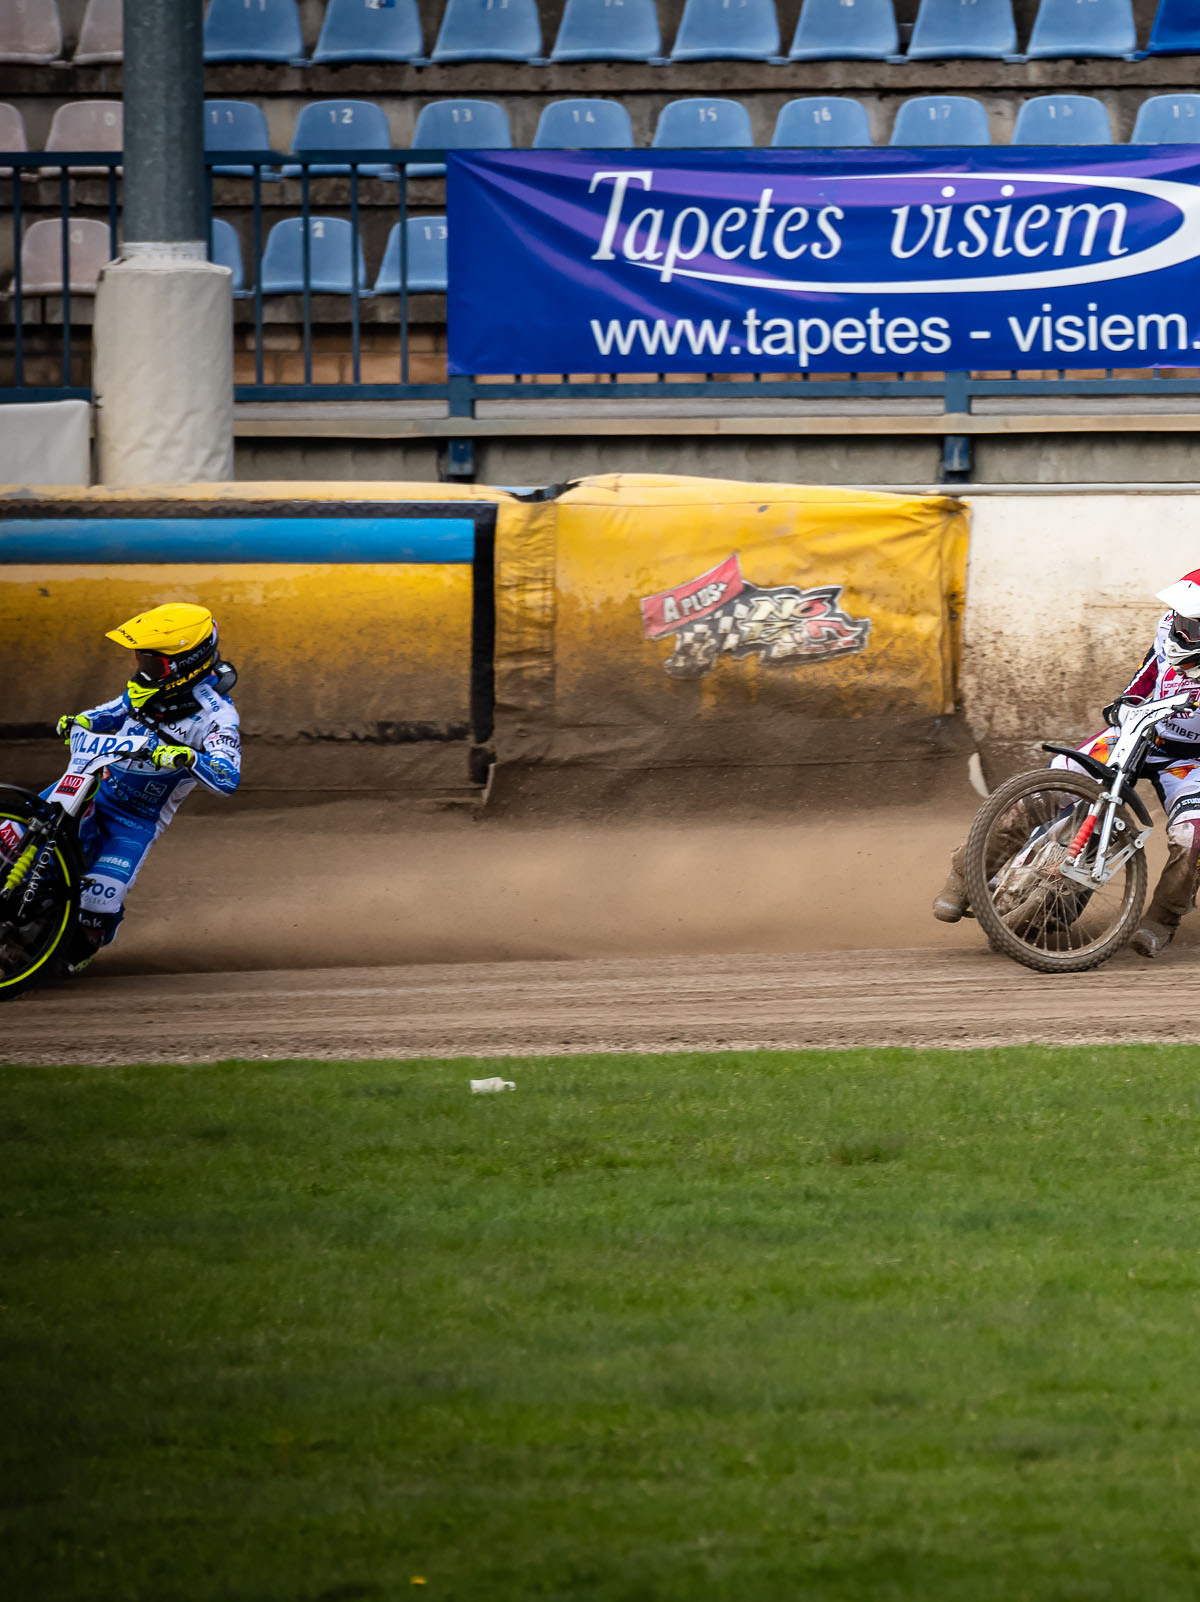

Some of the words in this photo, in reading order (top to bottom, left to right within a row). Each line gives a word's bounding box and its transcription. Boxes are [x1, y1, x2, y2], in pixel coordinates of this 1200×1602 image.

[209, 109, 235, 126] 11
[328, 106, 354, 124] 12
[451, 108, 474, 124] 13
[572, 109, 596, 125] 14
[698, 106, 719, 123] 15
[812, 107, 833, 125] 16
[588, 171, 845, 283] Tapetes
[890, 184, 1130, 259] visiem
[591, 308, 951, 368] www.tapetes
[970, 331, 991, 339] -
